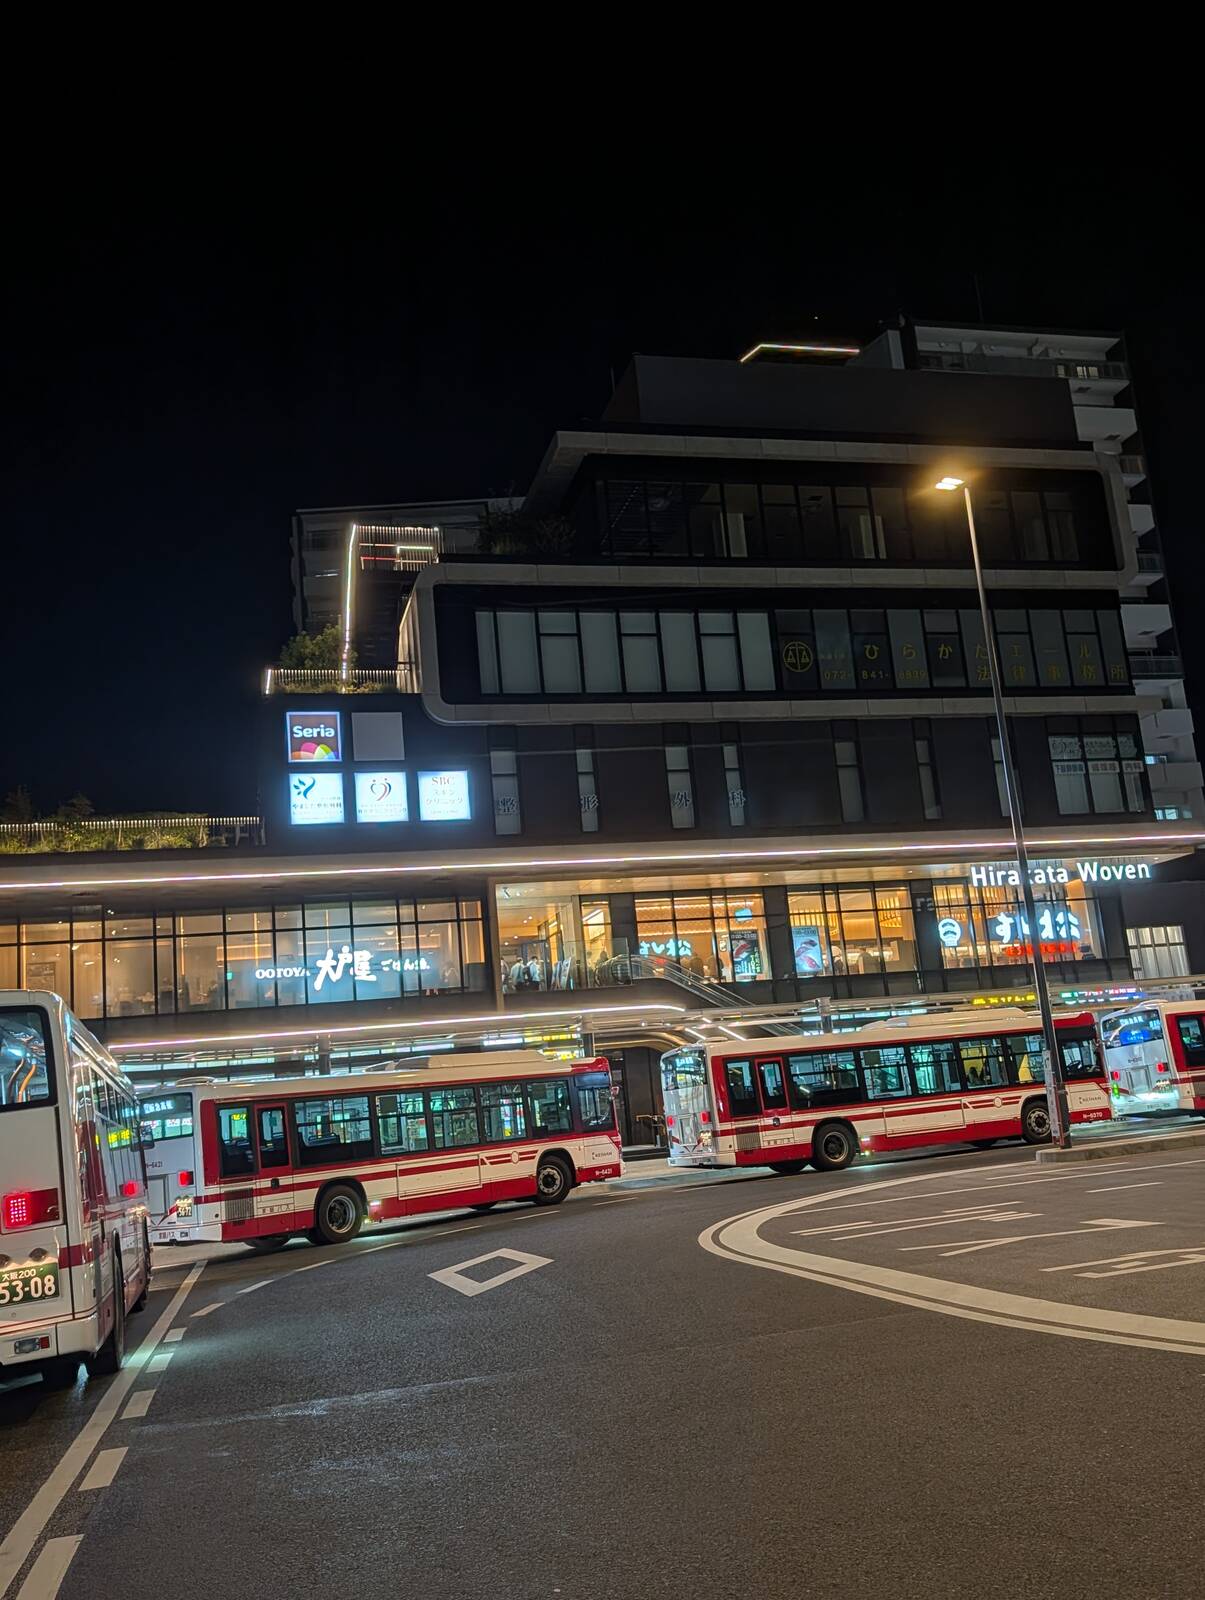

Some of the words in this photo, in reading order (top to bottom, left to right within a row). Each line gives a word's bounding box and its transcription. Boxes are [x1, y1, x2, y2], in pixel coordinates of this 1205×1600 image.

[293, 724, 335, 739] Seria
[431, 776, 455, 786] SBC
[971, 865, 1068, 887] Hiraata
[1076, 862, 1150, 883] Woven
[255, 967, 310, 979] OOTOYA
[313, 945, 377, 991] 大戸屋
[0, 1274, 56, 1304] 53-08
